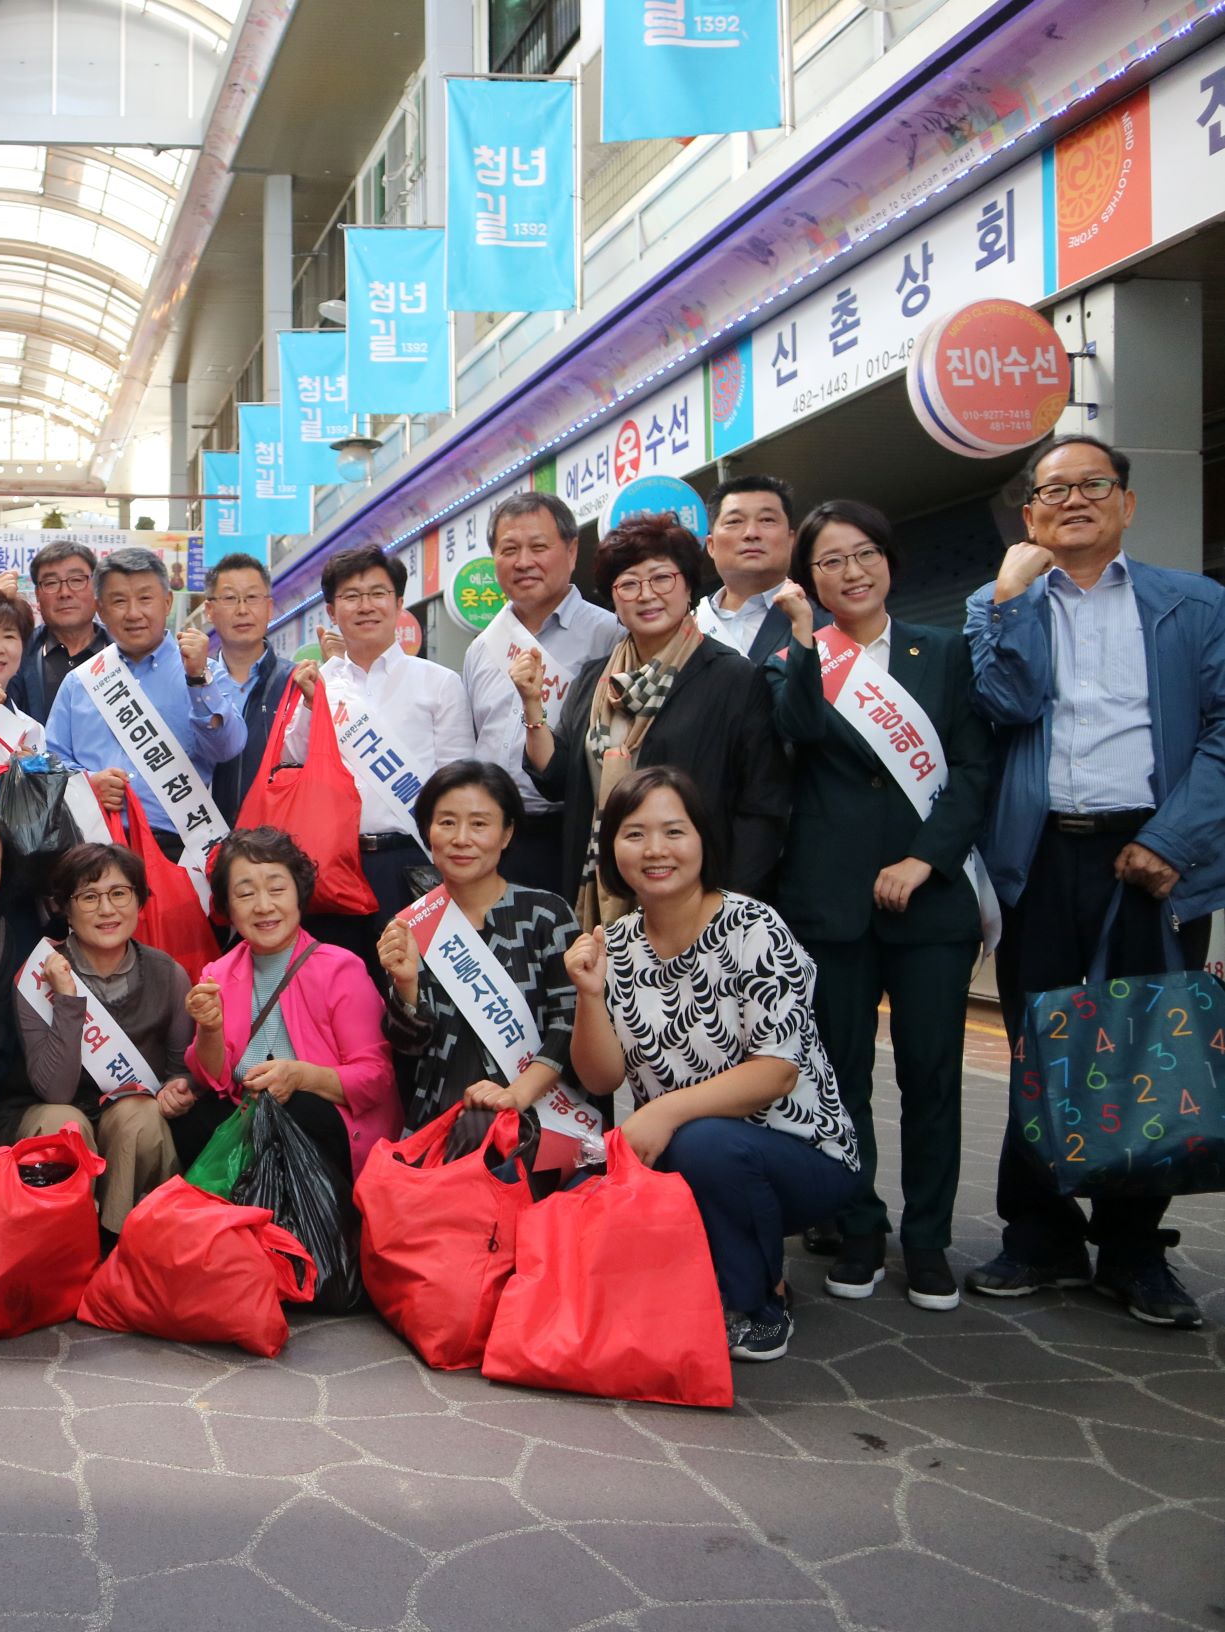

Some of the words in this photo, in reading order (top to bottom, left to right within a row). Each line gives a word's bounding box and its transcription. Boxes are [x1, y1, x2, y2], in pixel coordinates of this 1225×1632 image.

[693, 15, 741, 33] 1392
[1122, 111, 1134, 150] MEND
[473, 145, 546, 187] 청년
[1101, 158, 1132, 223] CLOTHES
[513, 223, 548, 237] 1392
[1067, 223, 1099, 248] STORE
[369, 281, 426, 313] 청년
[401, 342, 428, 353] 1392
[946, 346, 1060, 387] 진아수선
[792, 371, 848, 414] 482-1443
[326, 425, 348, 435] 1392
[469, 573, 497, 586] 에스
[821, 649, 855, 677] 유한국당
[103, 680, 175, 772] 국회의원
[853, 681, 936, 781] 사랑해요
[438, 934, 526, 1048] 전통시장과
[1072, 992, 1097, 1019] 5
[1049, 1011, 1069, 1038] 2
[1167, 1008, 1192, 1036] 2
[1096, 1028, 1115, 1053] 4
[1087, 1062, 1107, 1090] 6
[1133, 1074, 1157, 1103] 2
[1180, 1089, 1201, 1115] 4
[1098, 1103, 1121, 1133] 5
[1142, 1113, 1164, 1140] 6
[1066, 1133, 1086, 1161] 2
